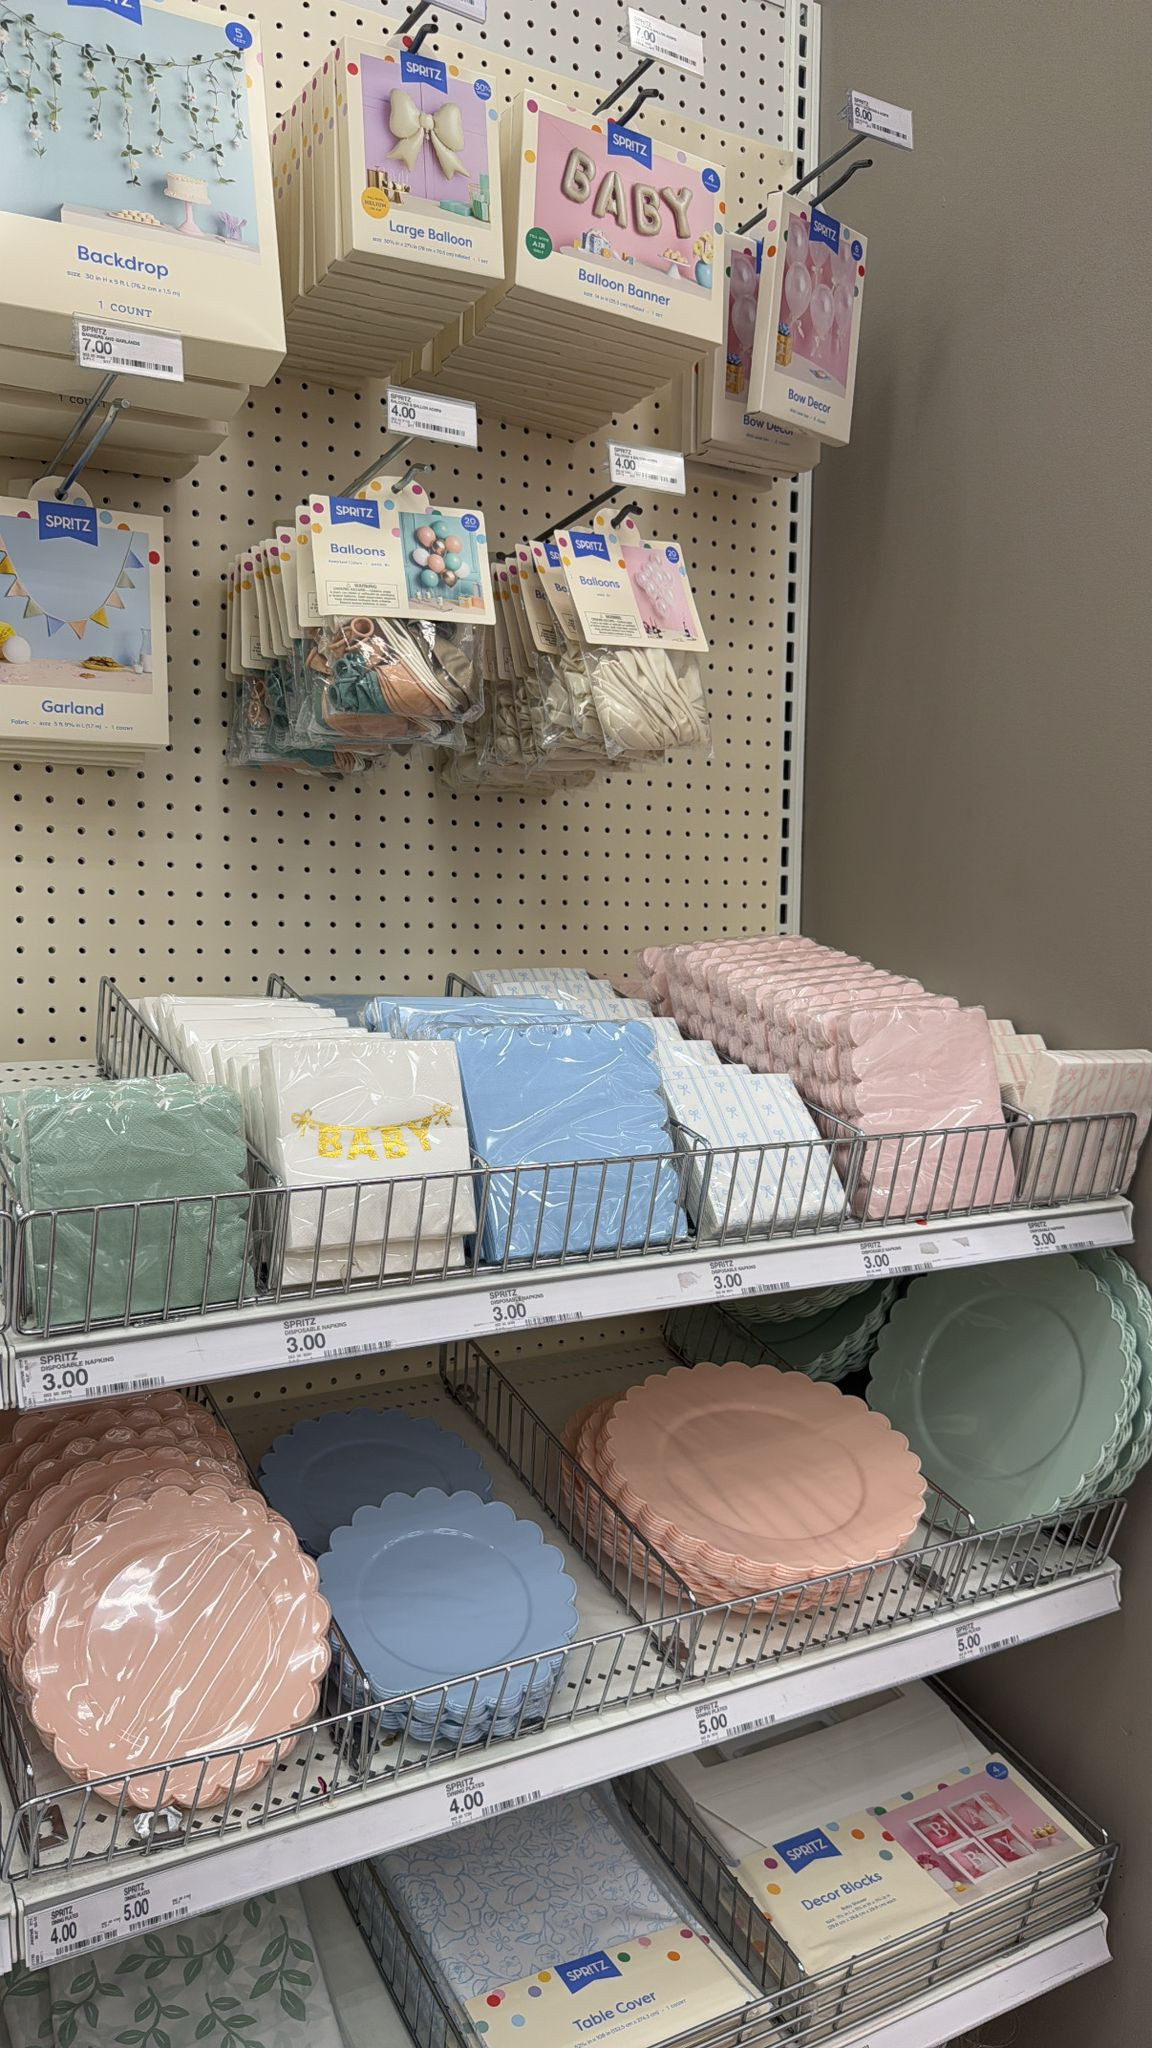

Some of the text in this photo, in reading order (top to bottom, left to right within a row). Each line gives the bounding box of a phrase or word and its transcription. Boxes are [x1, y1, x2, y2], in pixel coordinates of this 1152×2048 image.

[235, 28, 243, 38] 5
[636, 26, 656, 43] 7.00
[406, 61, 442, 81] SPRITZ
[612, 132, 647, 157] SPRITZ
[708, 174, 715, 184] 4
[560, 147, 694, 240] BABY
[390, 220, 473, 249] Large Balloon
[813, 220, 837, 242] SPRITZ
[77, 244, 169, 280] Backdrop
[578, 268, 671, 306] Balloon Banner
[98, 300, 153, 319] 1 COUNT
[82, 325, 107, 336] SPRITZ
[82, 338, 113, 356] 7.00
[70, 395, 107, 409] COUT
[788, 388, 831, 415] Bow Decor
[391, 404, 416, 420] 4.00
[743, 414, 765, 429] Bow
[615, 457, 636, 472] 4.00
[336, 504, 375, 519] SPRITZ
[46, 515, 92, 533] SPRITZ
[464, 517, 477, 526] 20
[330, 543, 386, 557] Balloons
[575, 539, 604, 553] SPRITZ
[579, 575, 621, 590] Balloons
[41, 700, 104, 716] Garland
[318, 1116, 433, 1161] BABY
[860, 1241, 881, 1250] SPRITZ
[1032, 1232, 1056, 1246] 3.00
[710, 1260, 734, 1270] SPRITZ
[863, 1253, 889, 1269] 3.00
[713, 1272, 743, 1290] 3.00
[490, 1289, 517, 1300] SPRITZ
[493, 1303, 526, 1322] 3.00
[284, 1317, 316, 1330] SPRITZ
[284, 1321, 347, 1336] DISPOSABLE NAPKINS
[286, 1333, 326, 1354] 3.00
[40, 1352, 78, 1366] SPRITZ
[41, 1356, 115, 1372] DISPOSABLE NAPKINS
[42, 1368, 89, 1391] 3.00
[956, 1622, 975, 1634] SPRITZ
[958, 1633, 981, 1652] 5.00
[694, 1700, 719, 1714] SPRITZ
[699, 1713, 728, 1735] 5.00
[446, 1777, 474, 1792] SPRITZ
[446, 1782, 485, 1798] DINING PLATES
[450, 1790, 484, 1814] 4.00
[786, 1838, 828, 1861] SPRITZ
[124, 1882, 145, 1896] SPRITZ
[801, 1888, 841, 1911] Decor
[840, 1872, 882, 1895] Blocks
[51, 1905, 74, 1920] SPRITZ
[124, 1897, 149, 1922] 5.00
[51, 1921, 77, 1944] 4.00
[566, 1960, 610, 1982] SPRITZ
[572, 1992, 656, 2031] Table Cover
